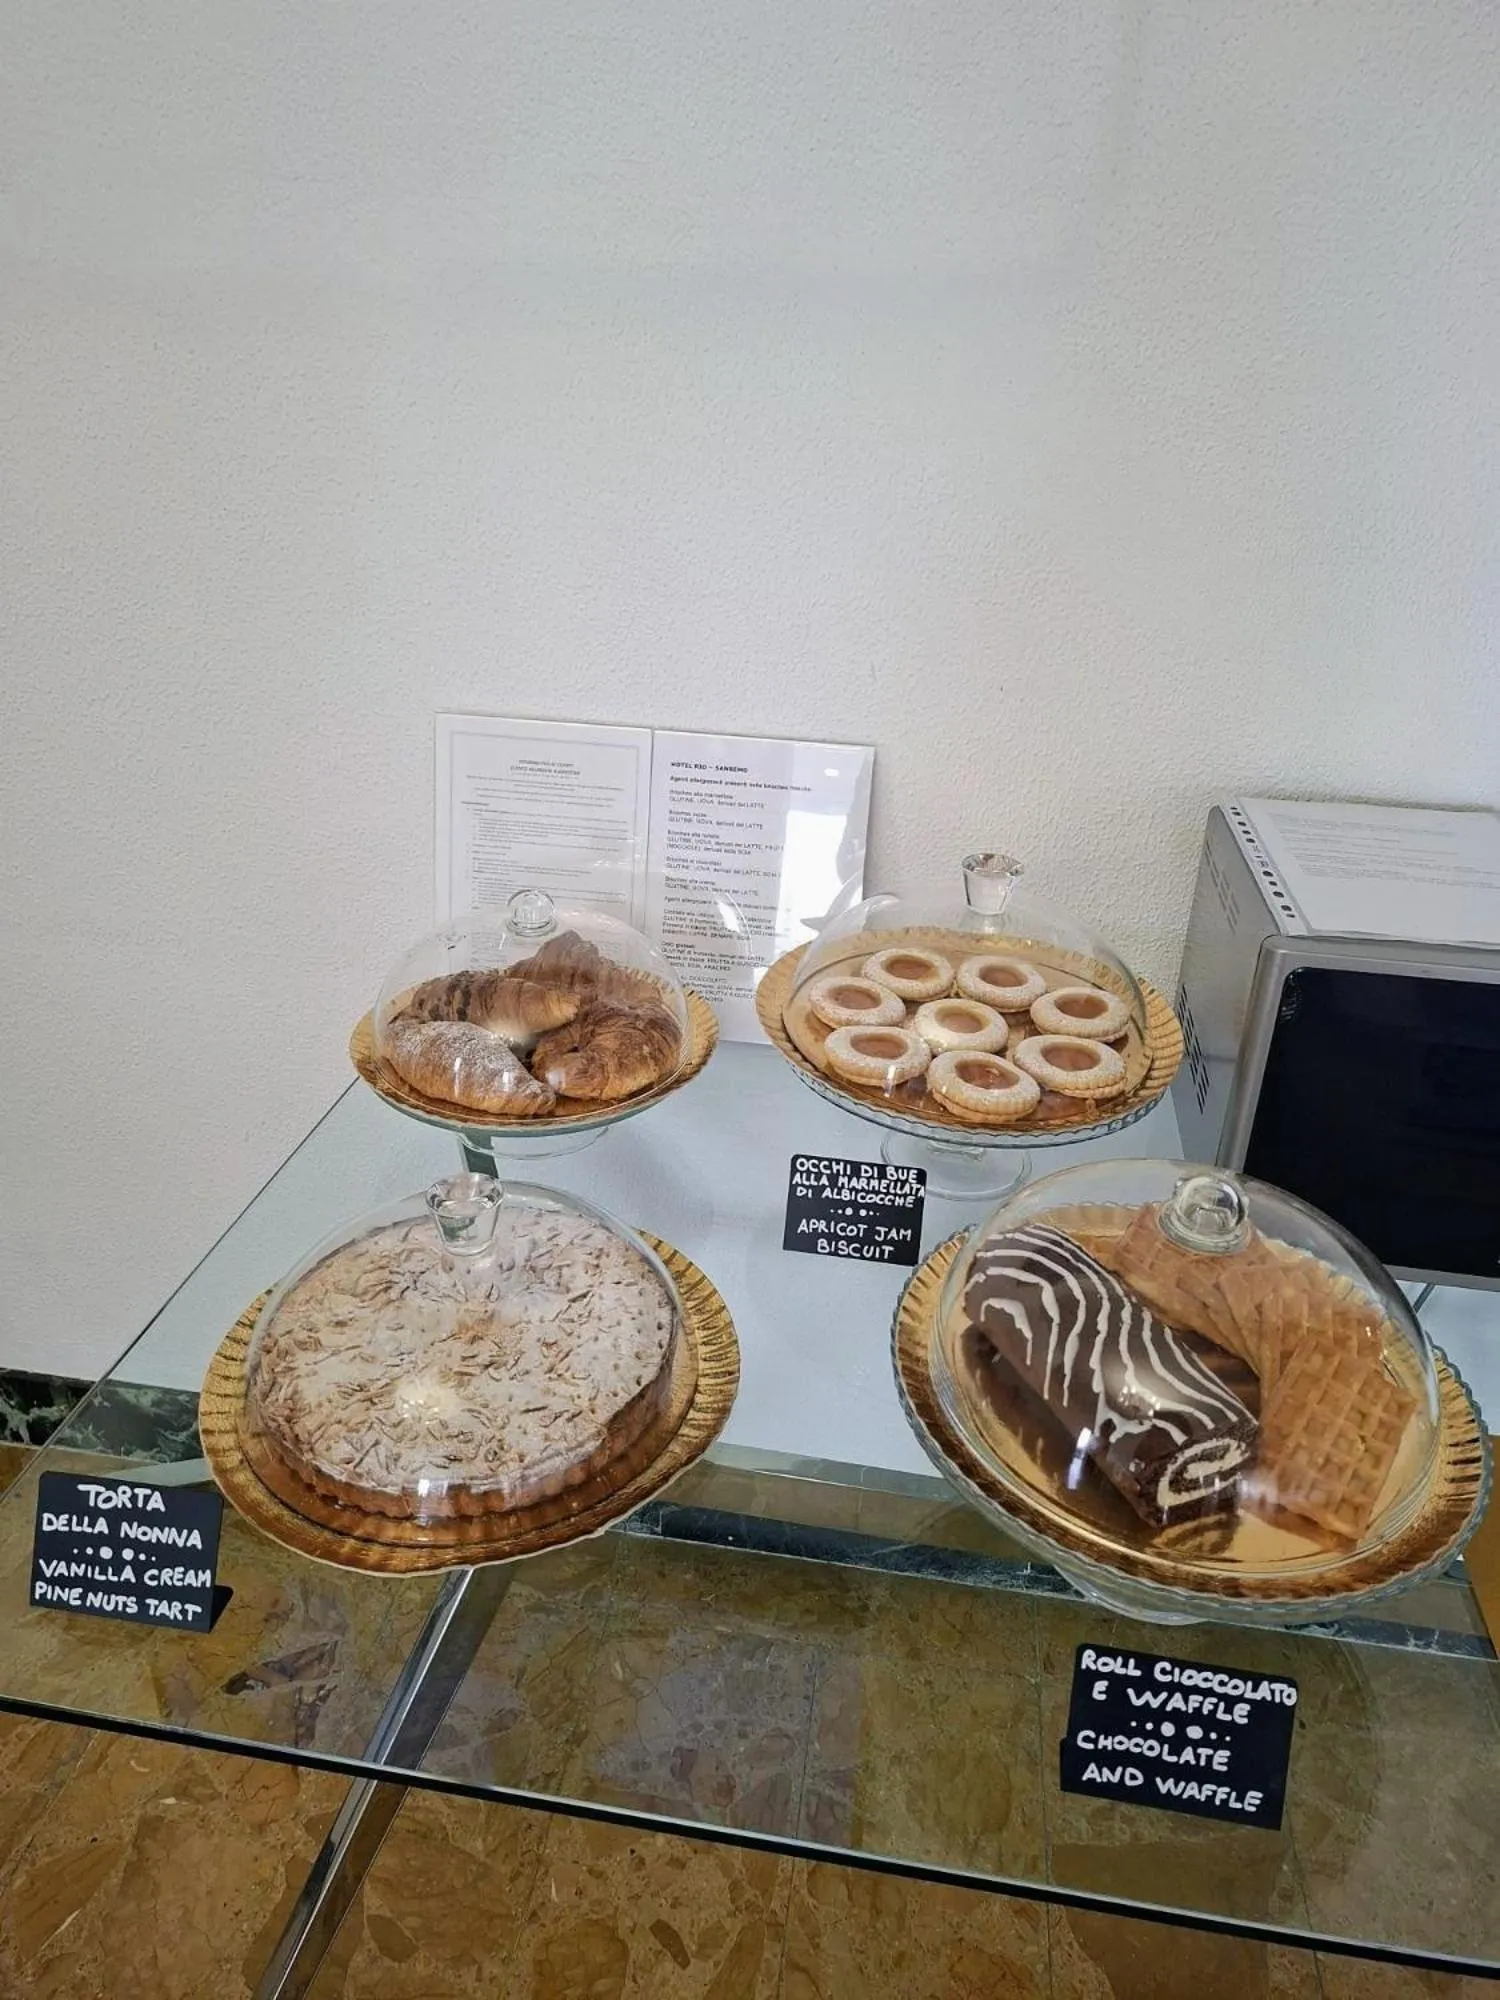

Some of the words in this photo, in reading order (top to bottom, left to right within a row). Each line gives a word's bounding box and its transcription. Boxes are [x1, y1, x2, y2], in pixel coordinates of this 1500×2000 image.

[715, 765, 748, 773] SANREMO
[792, 1172, 829, 1186] ALLA
[838, 1175, 925, 1198] MARMELLATA
[796, 1158, 851, 1175] OCCHI
[861, 1164, 878, 1178] DI
[886, 1166, 918, 1183] BUE
[796, 1187, 812, 1198] DI
[821, 1187, 915, 1208] ALBICOCCHE
[797, 1218, 868, 1237] APRICOT
[874, 1226, 912, 1241] JAM
[817, 1238, 894, 1259] BISCUIT
[77, 1484, 166, 1512] TORTA
[42, 1513, 109, 1534] DELLA
[120, 1521, 202, 1550] NONNA
[39, 1558, 136, 1583] VANILLA
[143, 1566, 211, 1588] CREAM
[35, 1581, 83, 1605] PINE
[86, 1592, 139, 1613] NUTS
[145, 1599, 202, 1622] TART
[1081, 1649, 1142, 1677] ROLL
[1153, 1661, 1297, 1706] CIOCCOLATO
[1092, 1680, 1109, 1700] E
[1126, 1687, 1250, 1724] WAFFLE
[1076, 1730, 1231, 1772] CHOCOLATE
[1081, 1763, 1144, 1786] AND
[1156, 1777, 1264, 1812] WAFFLE
